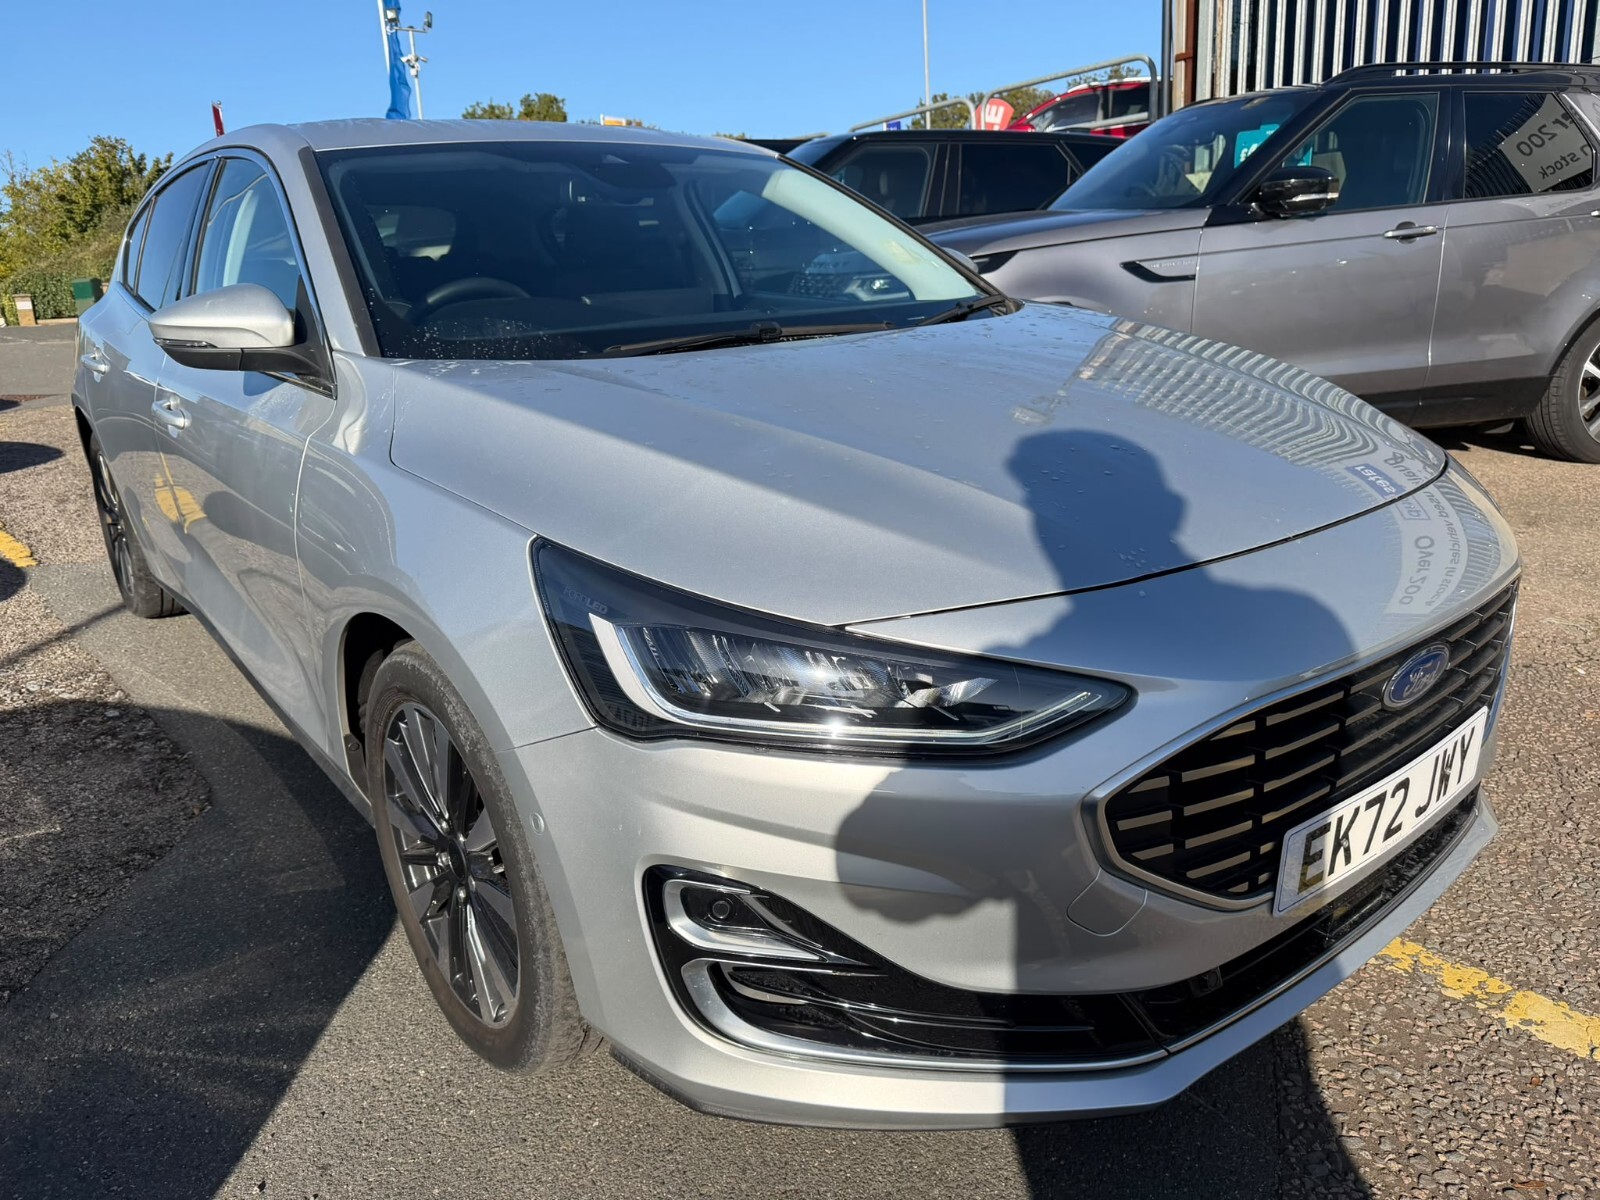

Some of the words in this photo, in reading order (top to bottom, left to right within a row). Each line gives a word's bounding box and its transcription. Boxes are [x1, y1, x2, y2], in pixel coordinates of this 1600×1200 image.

[1403, 660, 1441, 698] Ford
[1297, 777, 1410, 895] EK72
[1415, 726, 1476, 818] JWY
